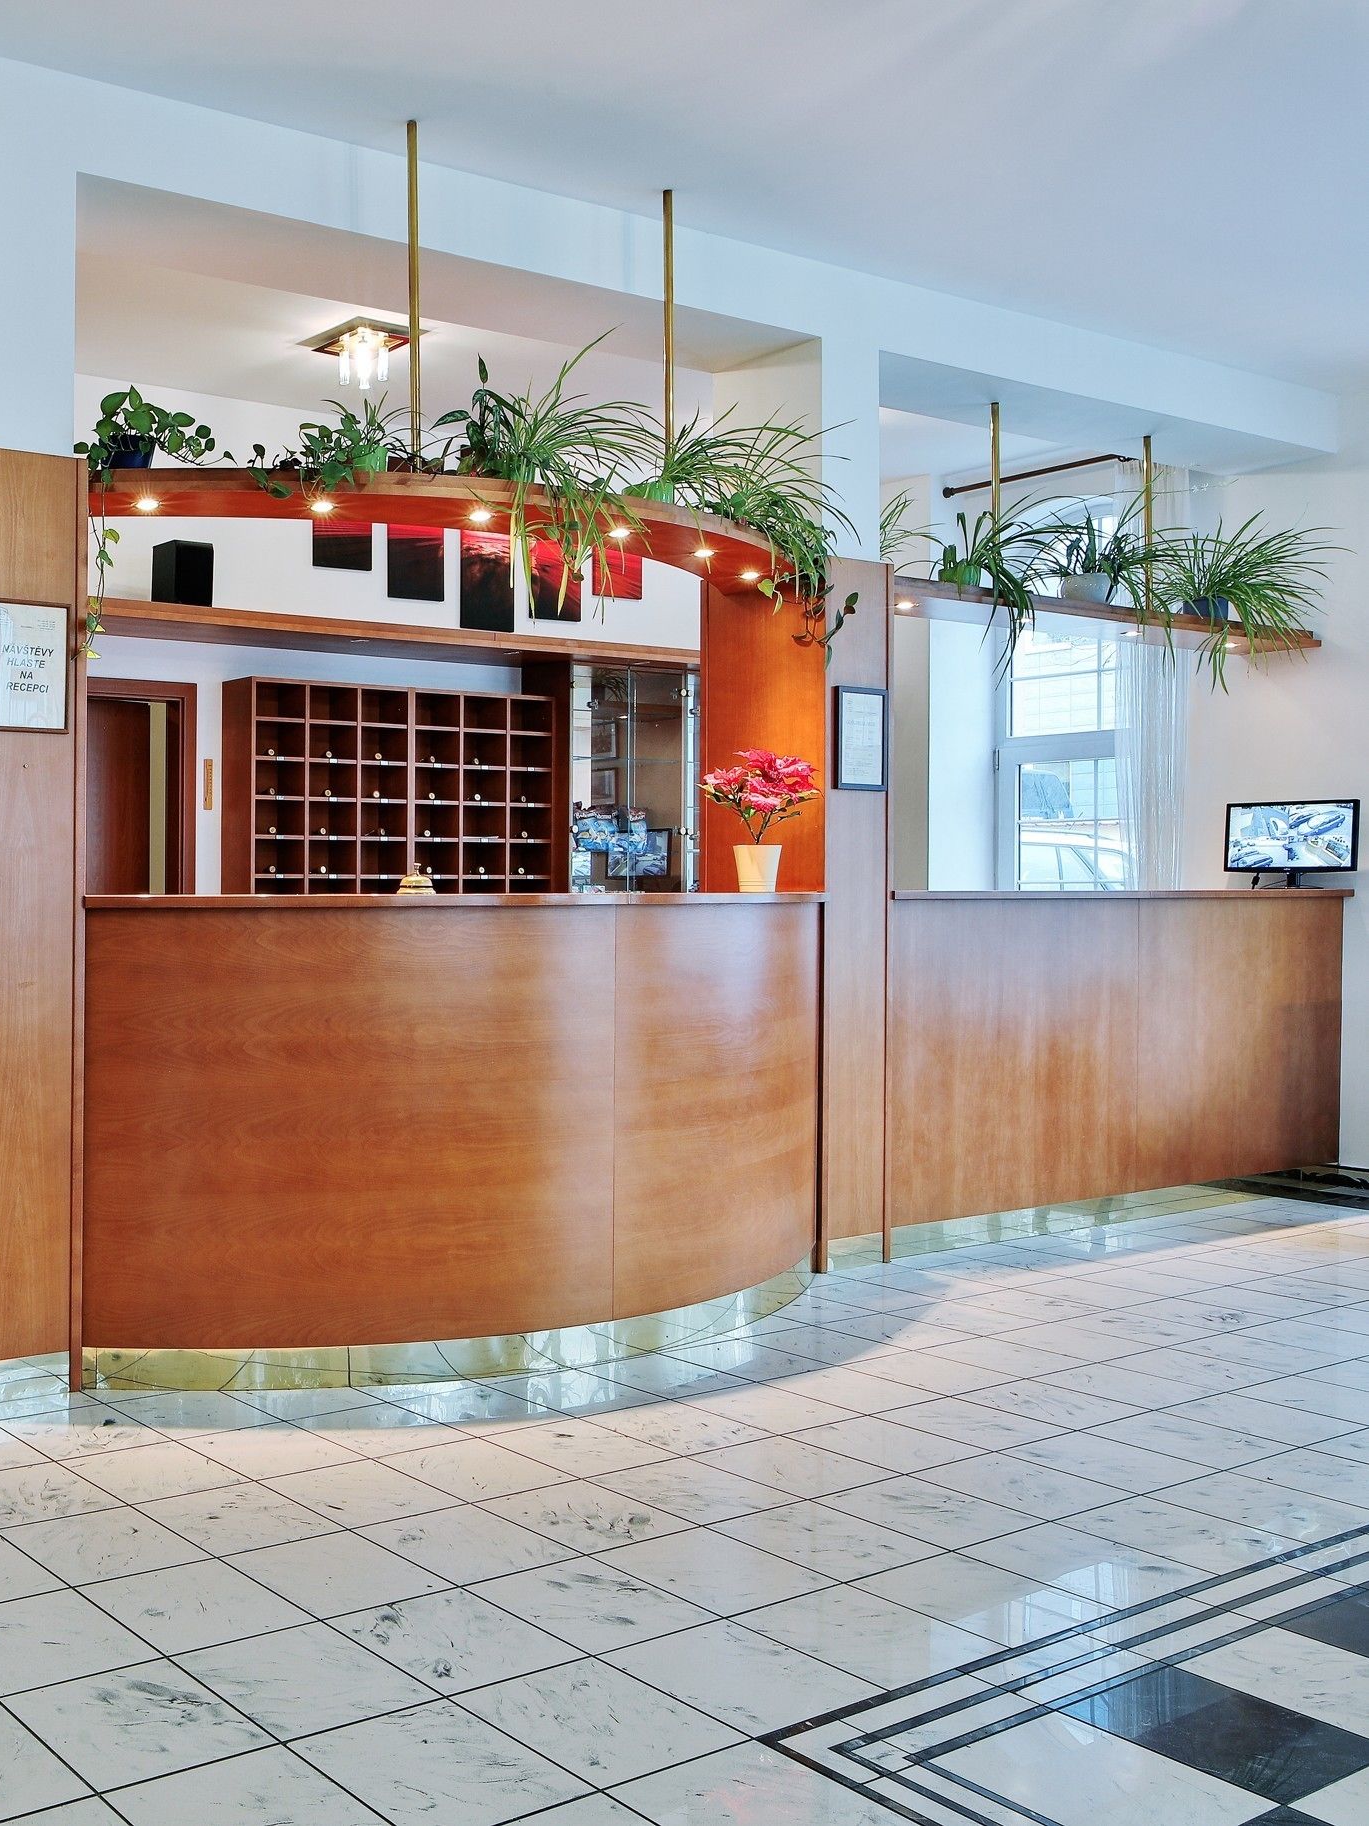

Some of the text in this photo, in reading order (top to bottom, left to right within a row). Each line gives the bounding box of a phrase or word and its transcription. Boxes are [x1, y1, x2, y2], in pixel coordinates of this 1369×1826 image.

[2, 643, 54, 657] NÁVŠTĚVY
[19, 671, 33, 679] NA
[6, 682, 49, 693] RECEPCI
